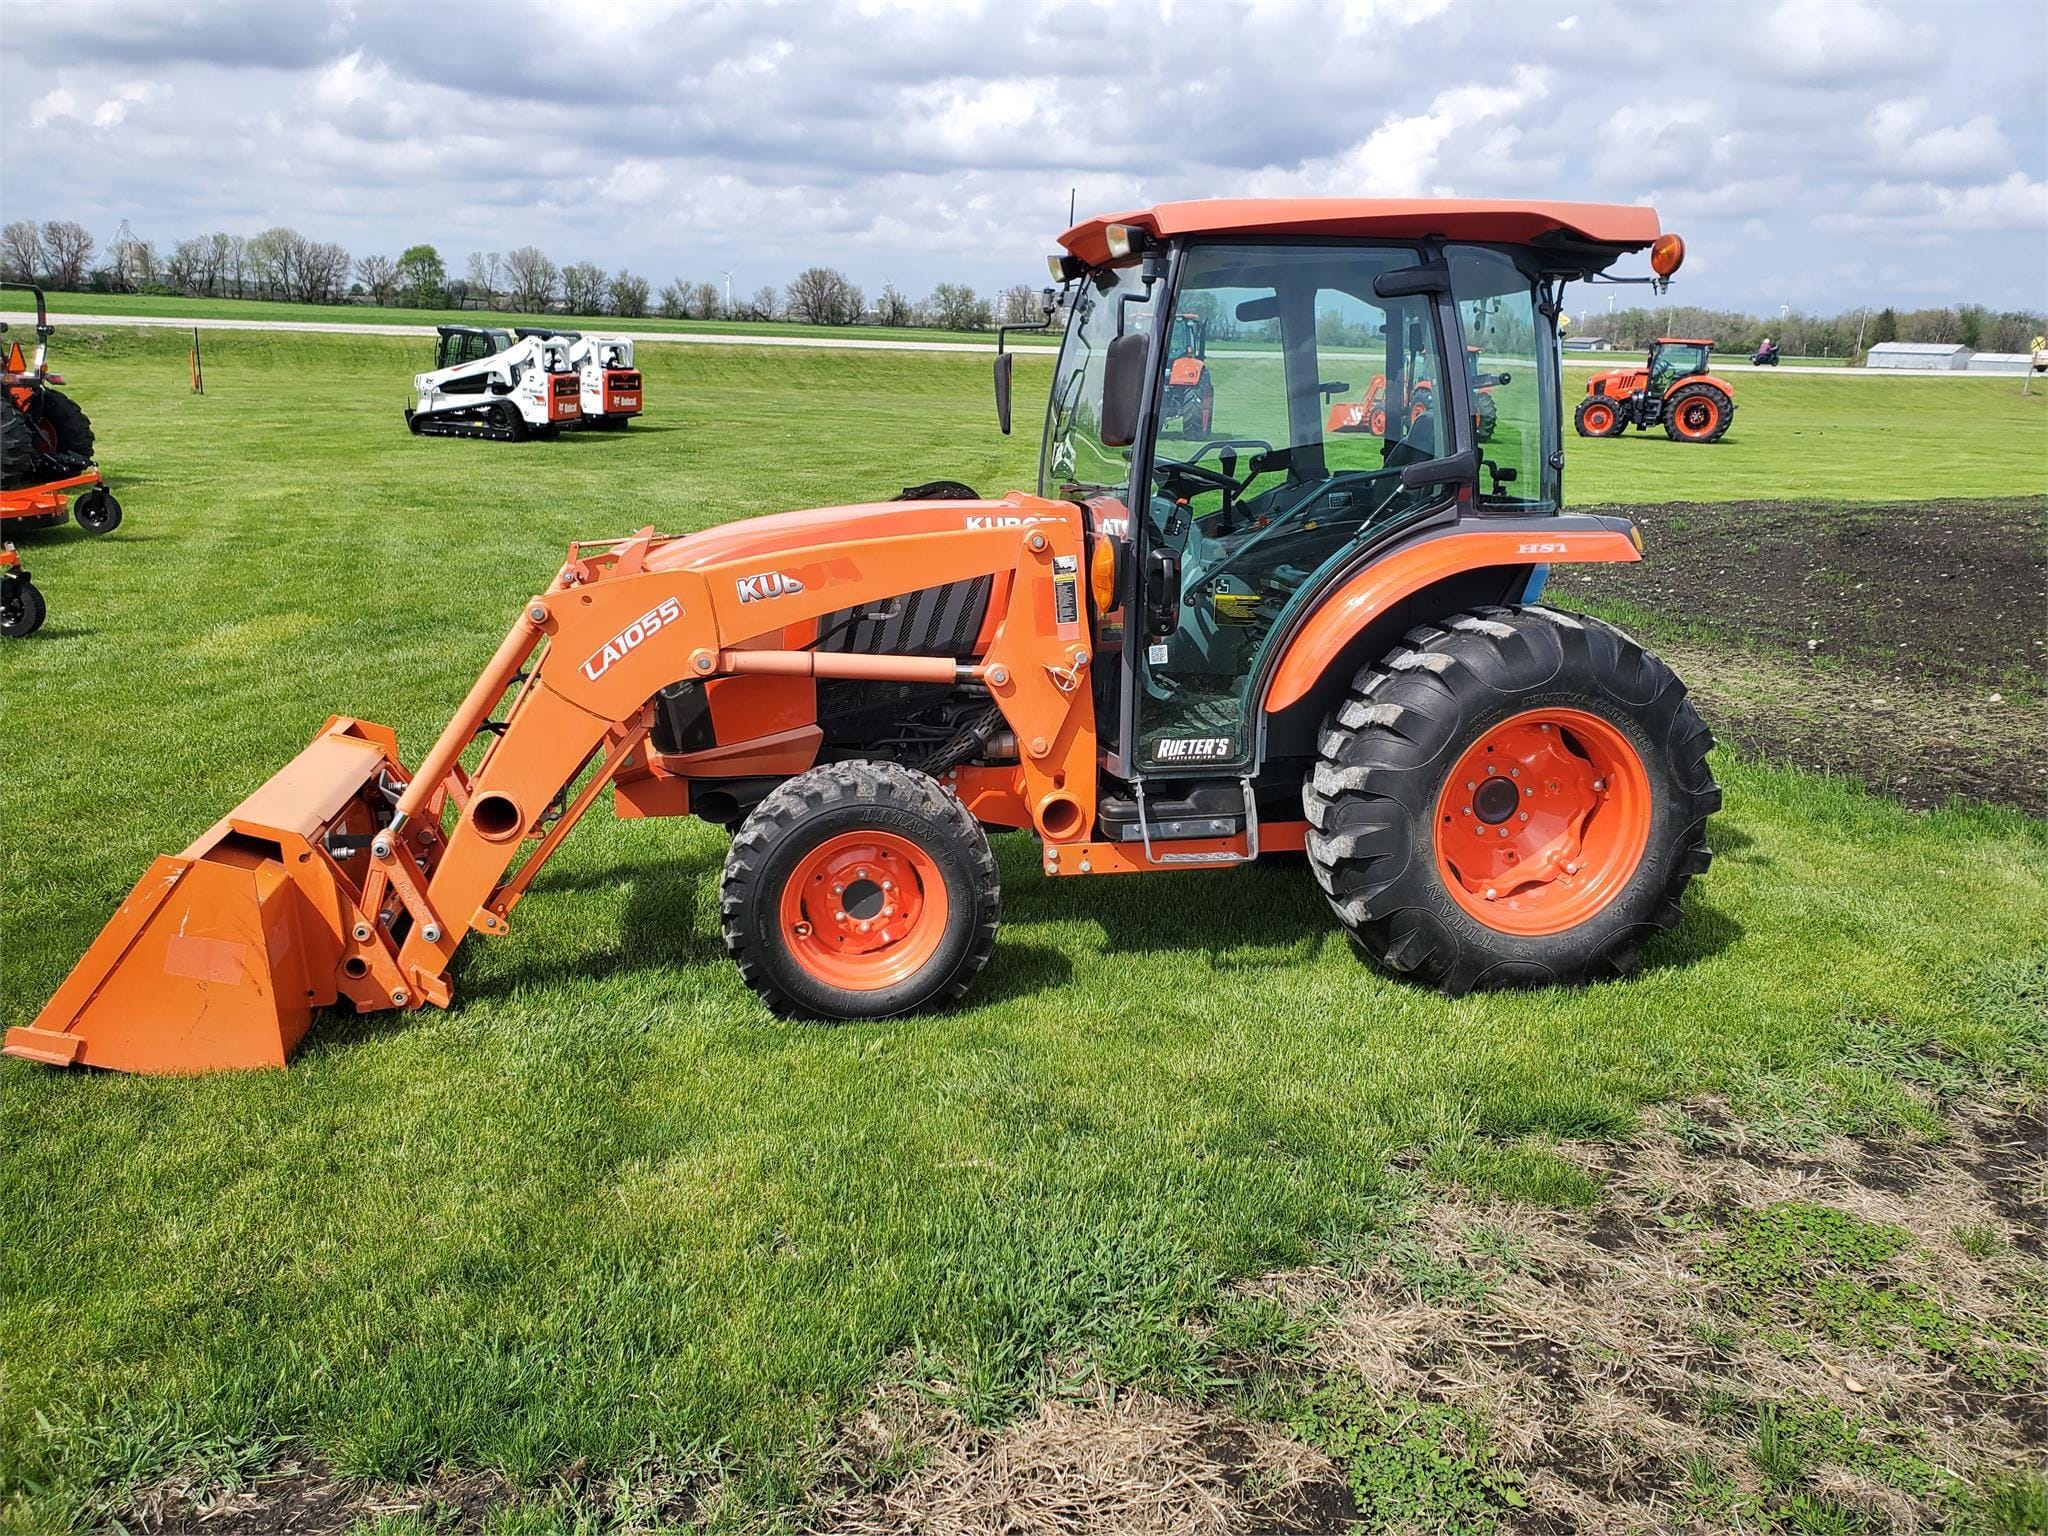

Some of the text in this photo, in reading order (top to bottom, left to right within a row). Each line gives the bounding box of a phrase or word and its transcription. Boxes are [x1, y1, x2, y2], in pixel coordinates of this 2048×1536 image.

[584, 598, 680, 681] LA1055
[1157, 738, 1229, 759] RUETER'S
[860, 805, 938, 842] TITAN
[1424, 881, 1497, 953] TITAN
